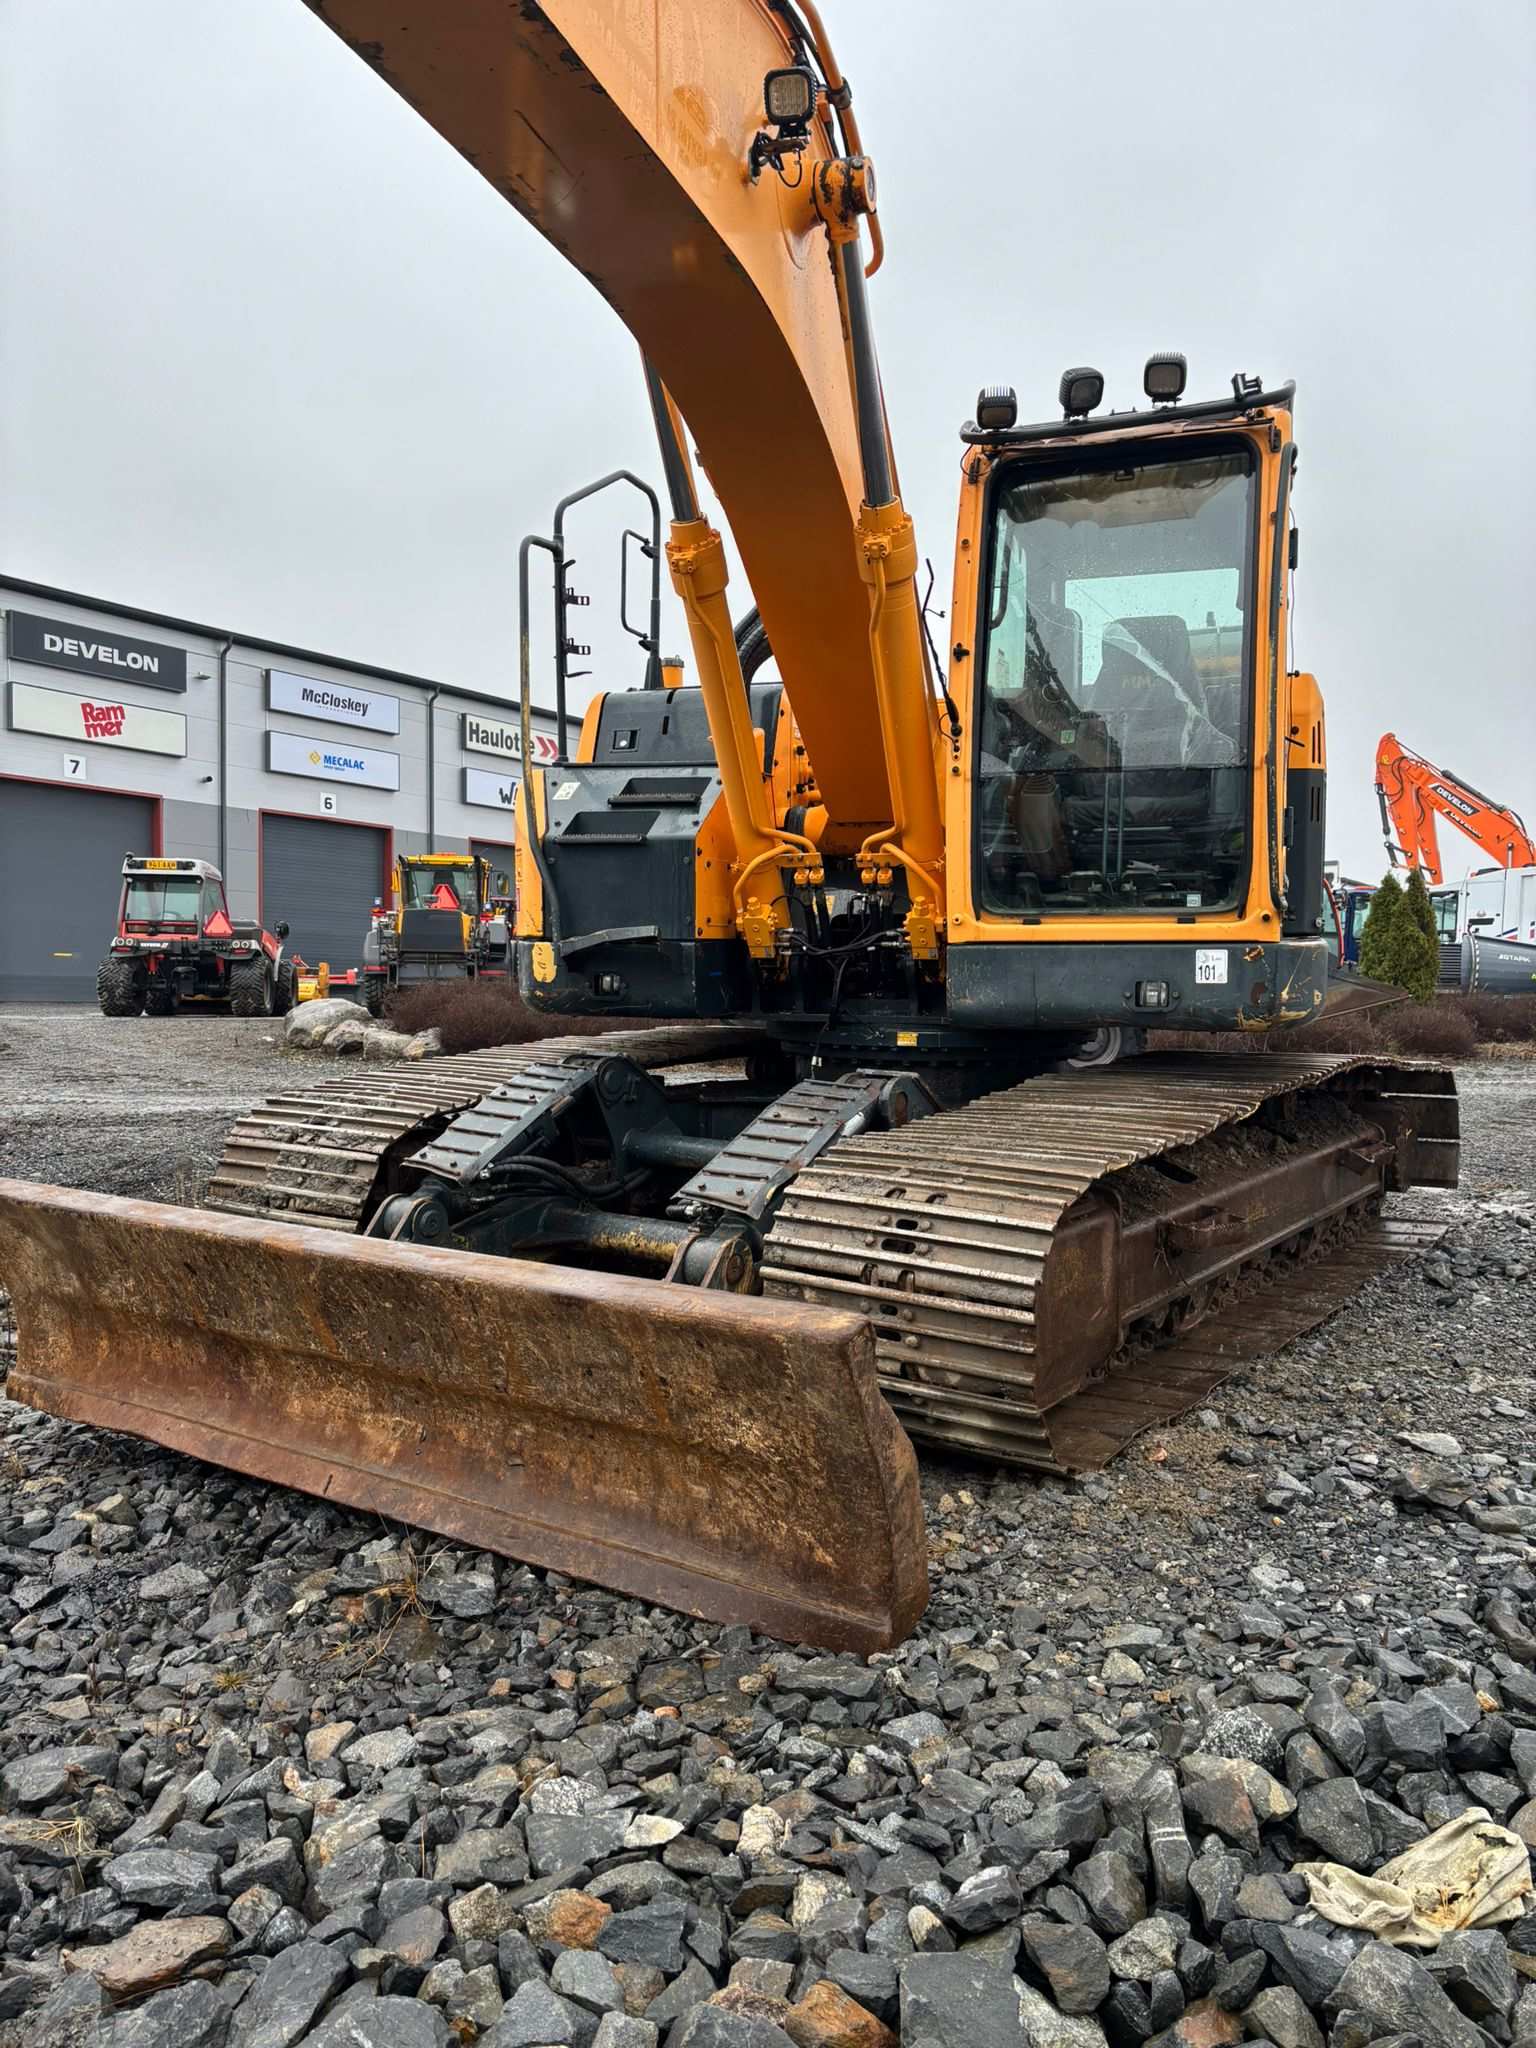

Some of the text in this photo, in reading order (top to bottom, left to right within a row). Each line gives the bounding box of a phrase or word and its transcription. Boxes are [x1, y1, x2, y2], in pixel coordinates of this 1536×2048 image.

[44, 633, 159, 673] DEVELON
[302, 688, 368, 717] McCloskey
[80, 703, 126, 722] Ram
[84, 720, 123, 738] mer
[469, 721, 535, 755] Haulote
[69, 759, 80, 774] 7
[323, 755, 365, 770] MECALAC
[324, 796, 333, 810] 6
[1437, 787, 1474, 815] DEVELON
[1198, 964, 1216, 981] 101
